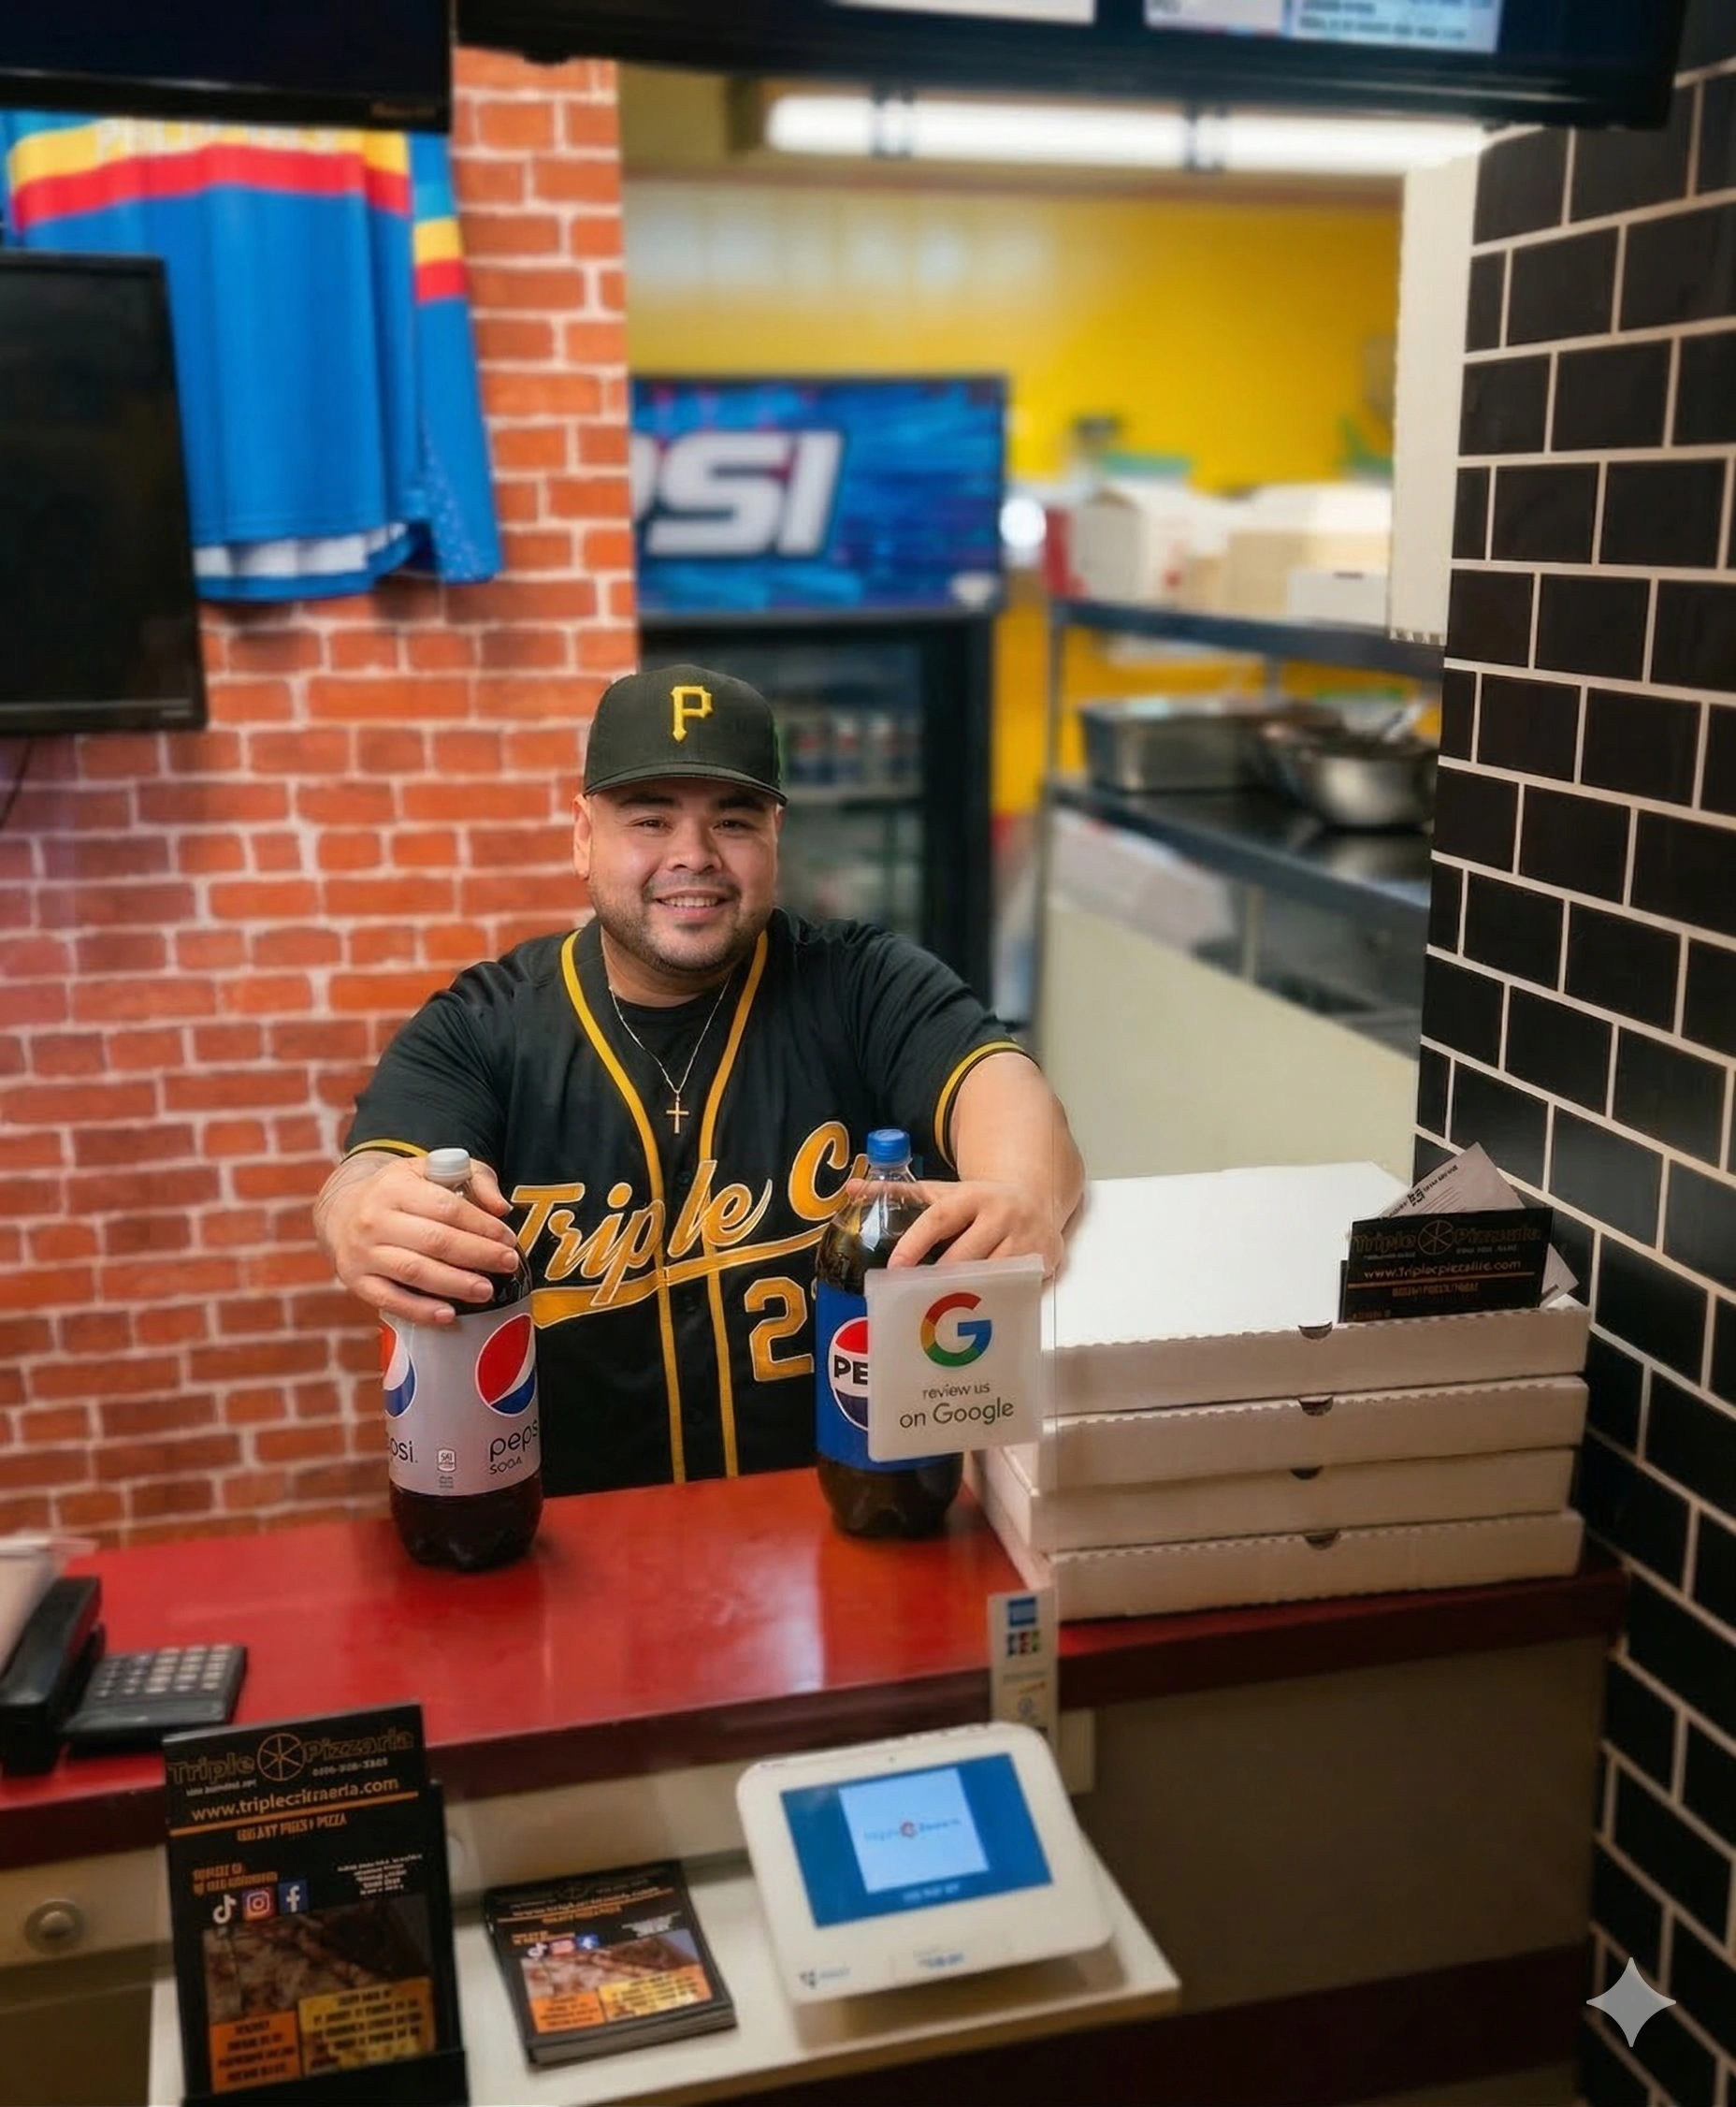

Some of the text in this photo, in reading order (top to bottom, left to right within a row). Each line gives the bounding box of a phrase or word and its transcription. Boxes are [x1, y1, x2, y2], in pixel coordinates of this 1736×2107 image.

[630, 431, 841, 556] SI
[671, 686, 713, 742] P
[511, 1121, 870, 1307] Triple C
[744, 1276, 817, 1382] 2
[920, 1292, 992, 1367] G
[833, 1354, 868, 1386] PE
[922, 1382, 991, 1401] review us
[899, 1397, 1015, 1430] on Google
[489, 1420, 538, 1462] peps
[489, 1456, 523, 1475] SODA
[167, 1751, 256, 1785] Triple
